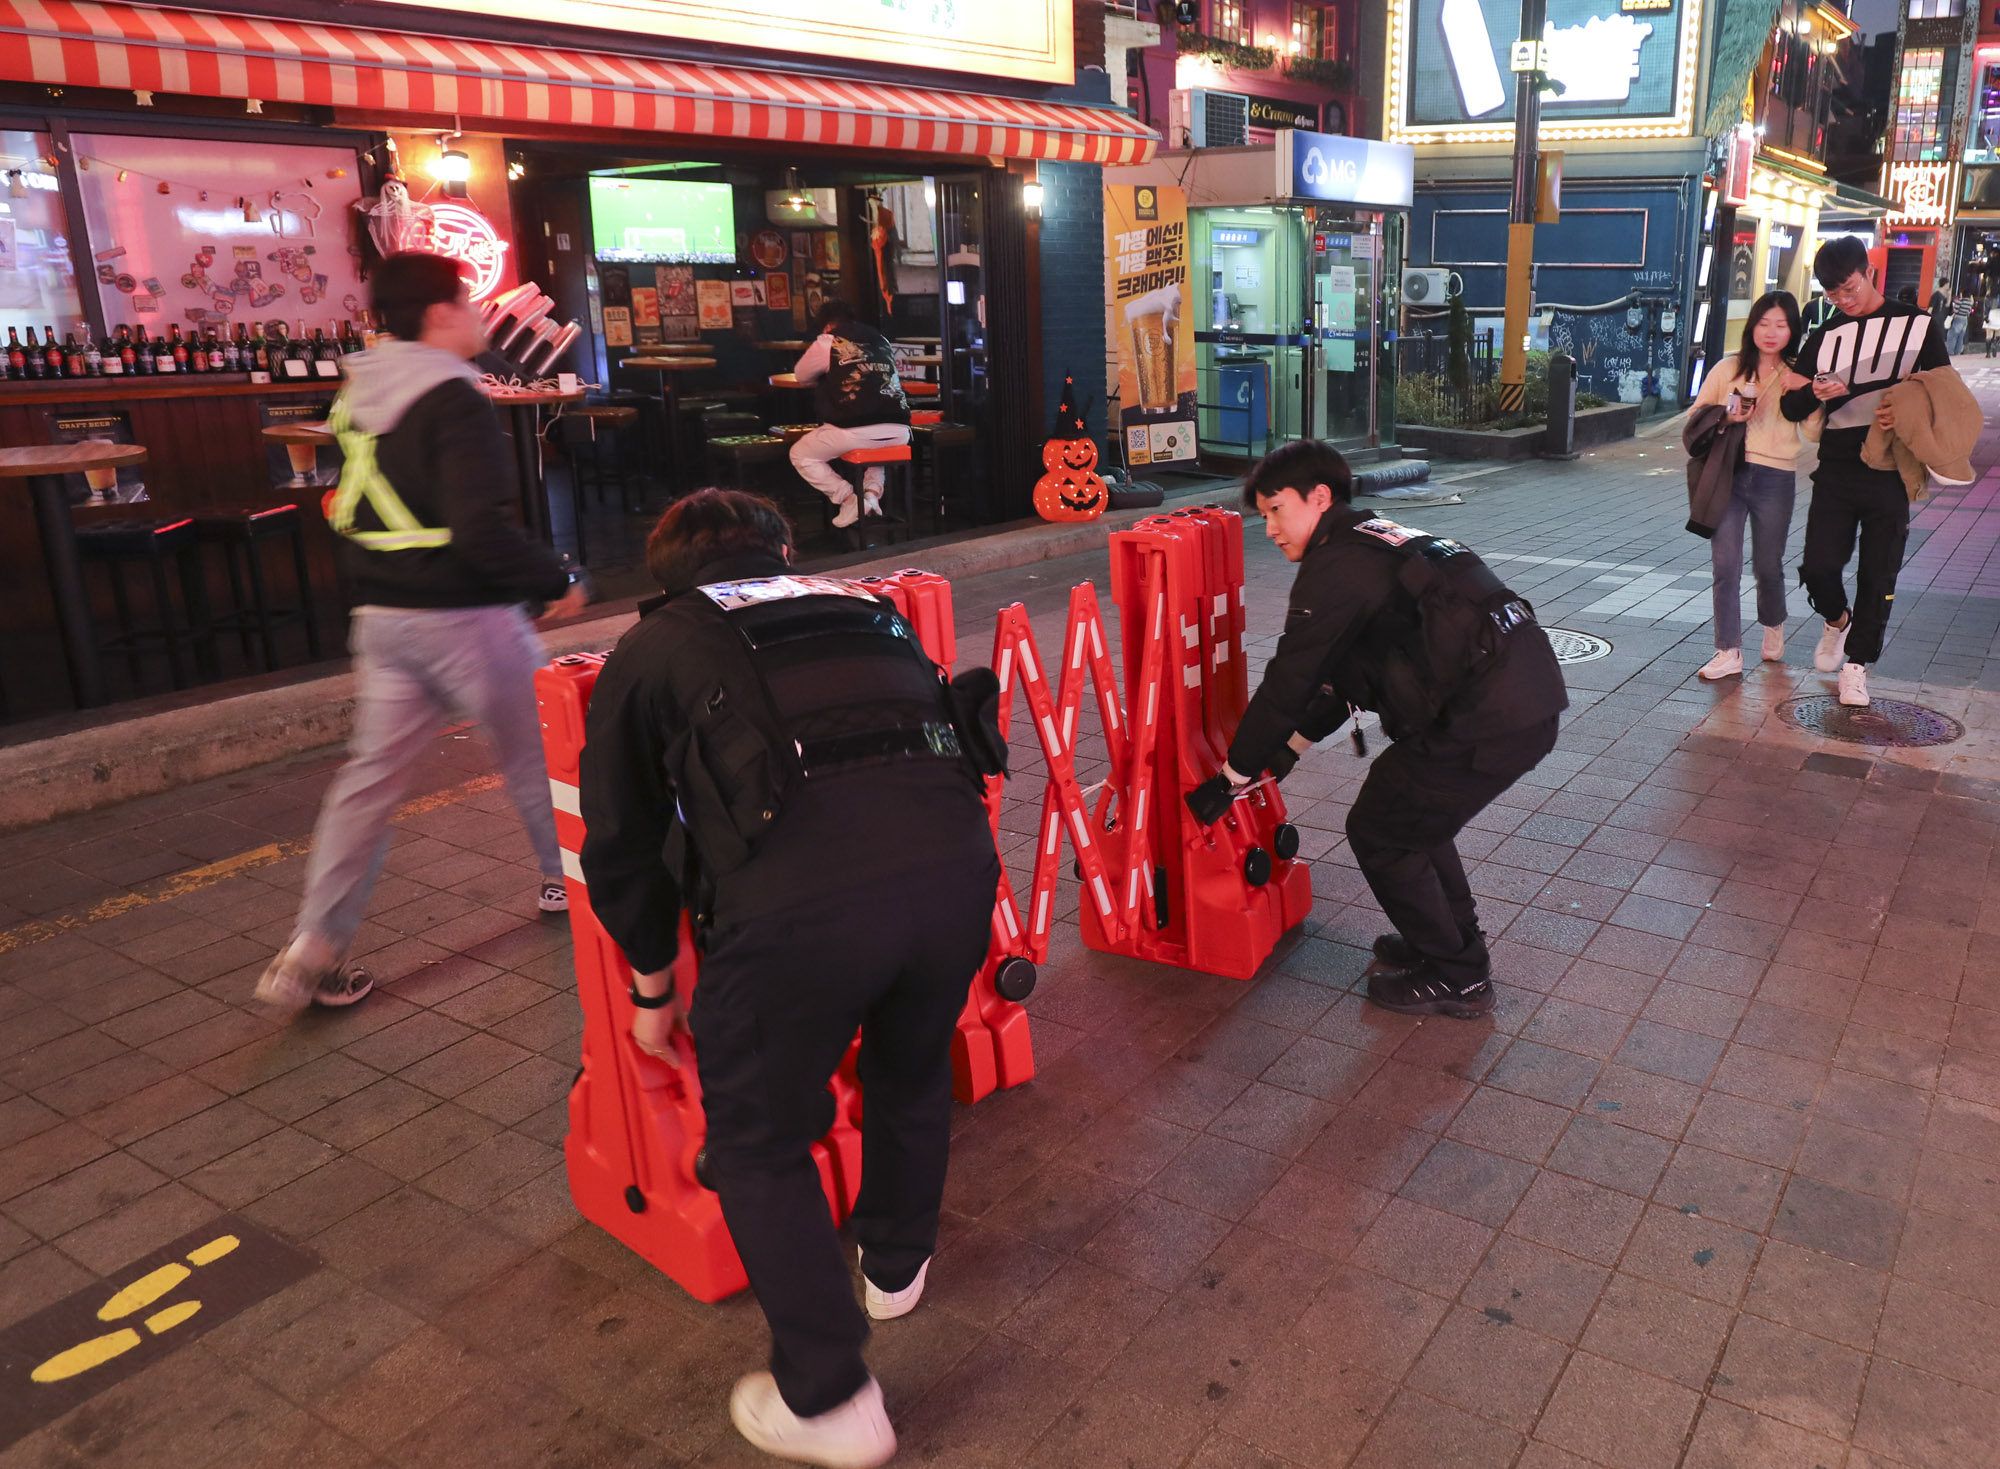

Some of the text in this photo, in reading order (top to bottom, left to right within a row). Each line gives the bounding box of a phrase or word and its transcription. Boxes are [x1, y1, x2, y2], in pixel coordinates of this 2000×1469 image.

[1250, 103, 1260, 118] &
[1330, 159, 1356, 183] MG
[1114, 221, 1184, 253] 가평에선!
[1114, 243, 1184, 275] 가평맥주!
[1116, 265, 1186, 299] 크래머리!
[58, 420, 111, 430] CRAFT BEER
